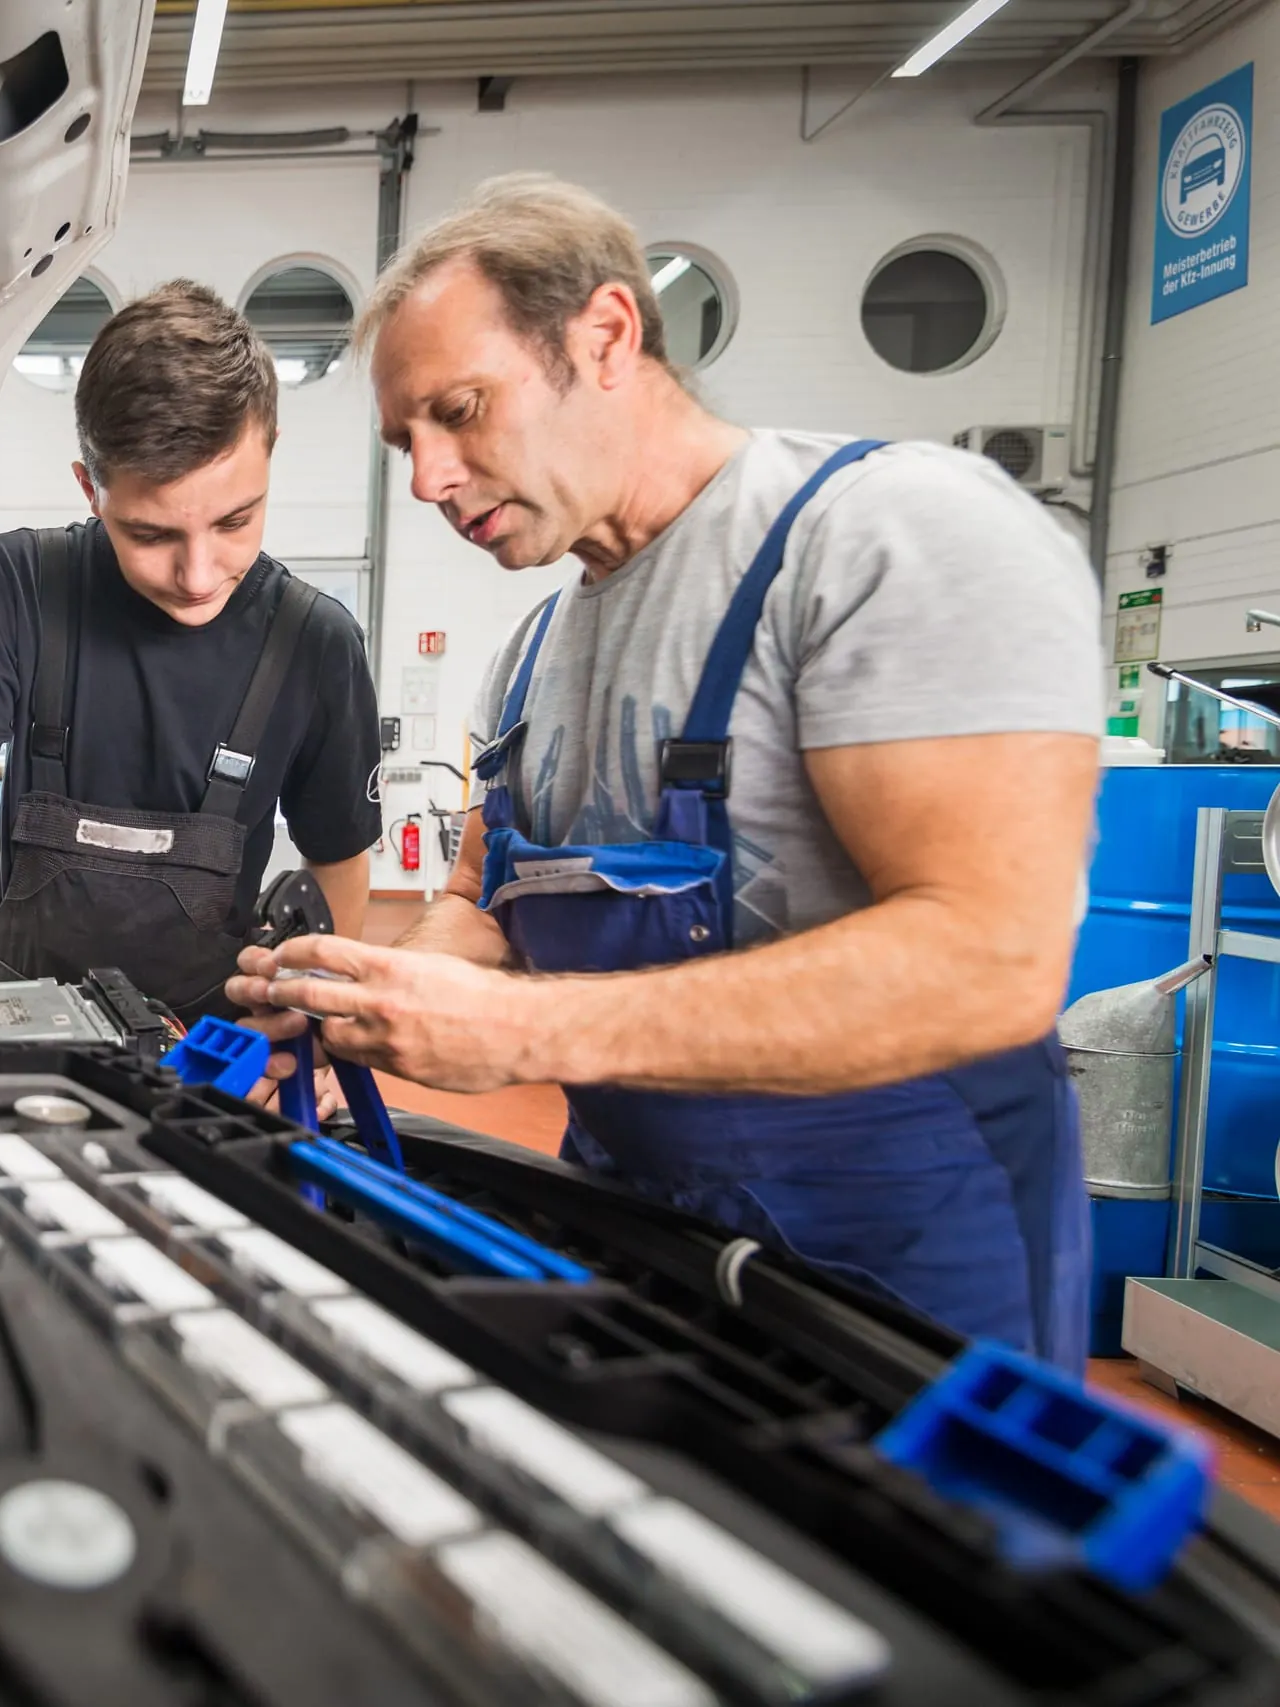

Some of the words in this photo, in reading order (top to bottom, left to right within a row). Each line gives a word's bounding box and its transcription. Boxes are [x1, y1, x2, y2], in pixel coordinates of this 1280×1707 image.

[1177, 191, 1226, 226] GEWERBE
[1162, 276, 1178, 296] der
[1180, 253, 1236, 288] Kfz-Innung
[1163, 235, 1237, 279] Meisterbetrieb
